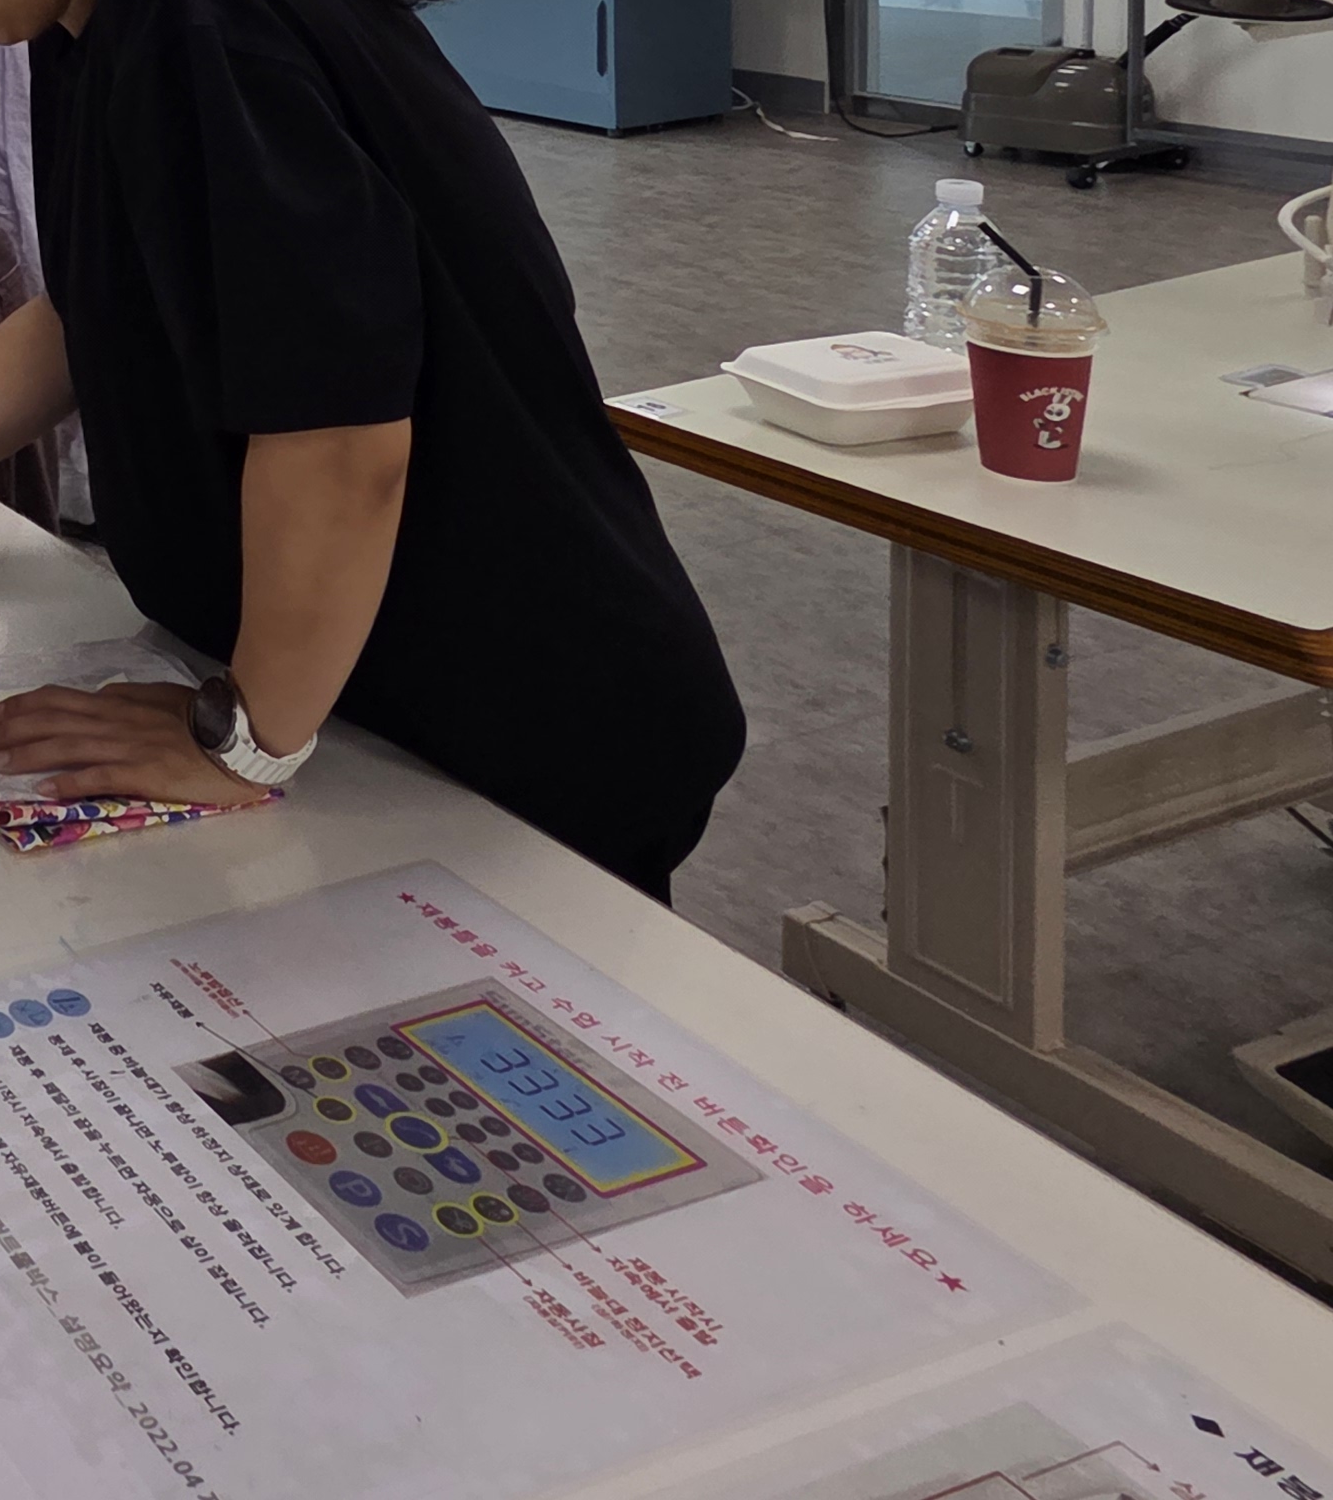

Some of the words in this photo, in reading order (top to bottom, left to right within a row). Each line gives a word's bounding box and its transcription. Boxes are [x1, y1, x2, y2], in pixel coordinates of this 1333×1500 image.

[479, 1047, 626, 1146] 3333
[499, 960, 546, 993] 켜고
[551, 997, 601, 1029] 수업
[600, 1035, 655, 1068] 시작
[656, 1071, 689, 1092] 전
[842, 1201, 938, 1271] 하세요
